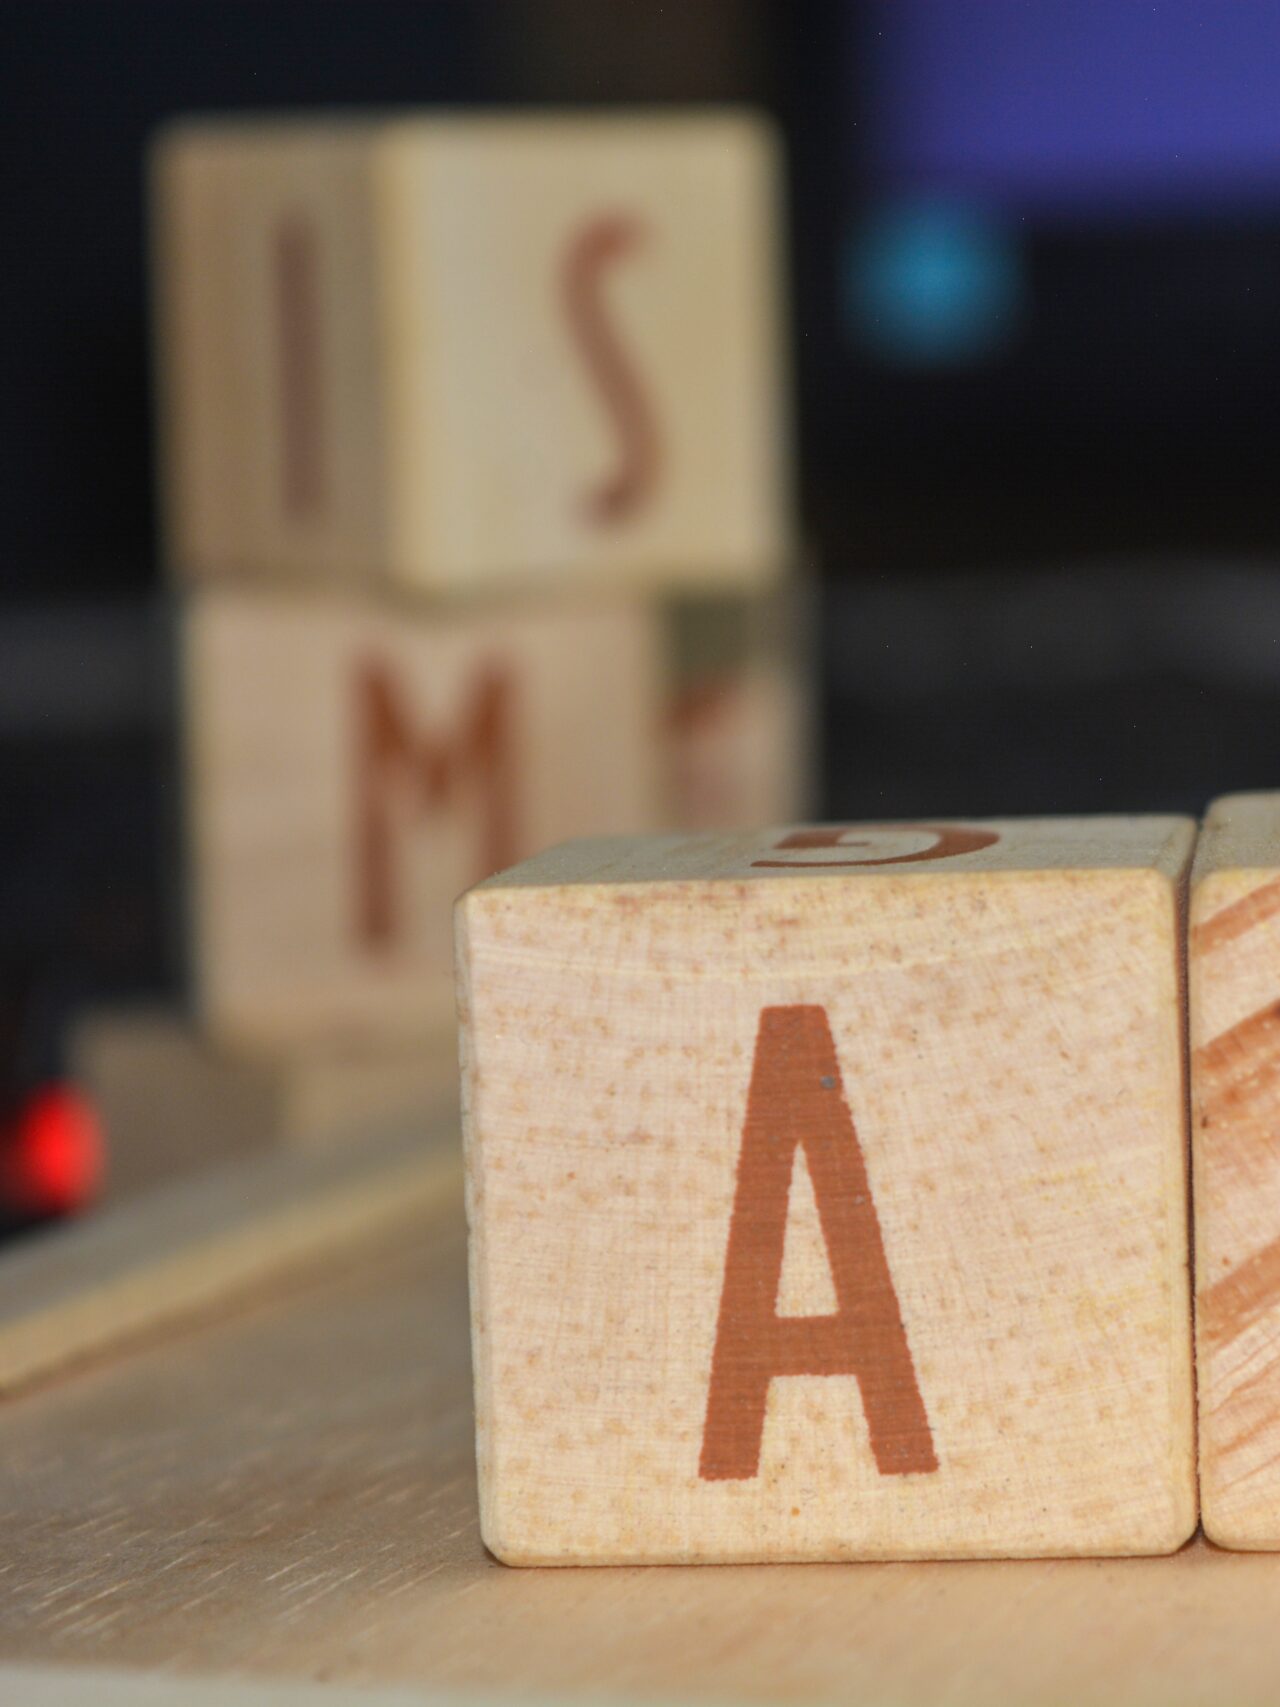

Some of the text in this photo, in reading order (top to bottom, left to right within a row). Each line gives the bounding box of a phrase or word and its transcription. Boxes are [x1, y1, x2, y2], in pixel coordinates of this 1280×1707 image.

[555, 206, 665, 532] S
[352, 645, 520, 956] M
[749, 825, 1000, 868] G
[698, 1004, 940, 1482] A
